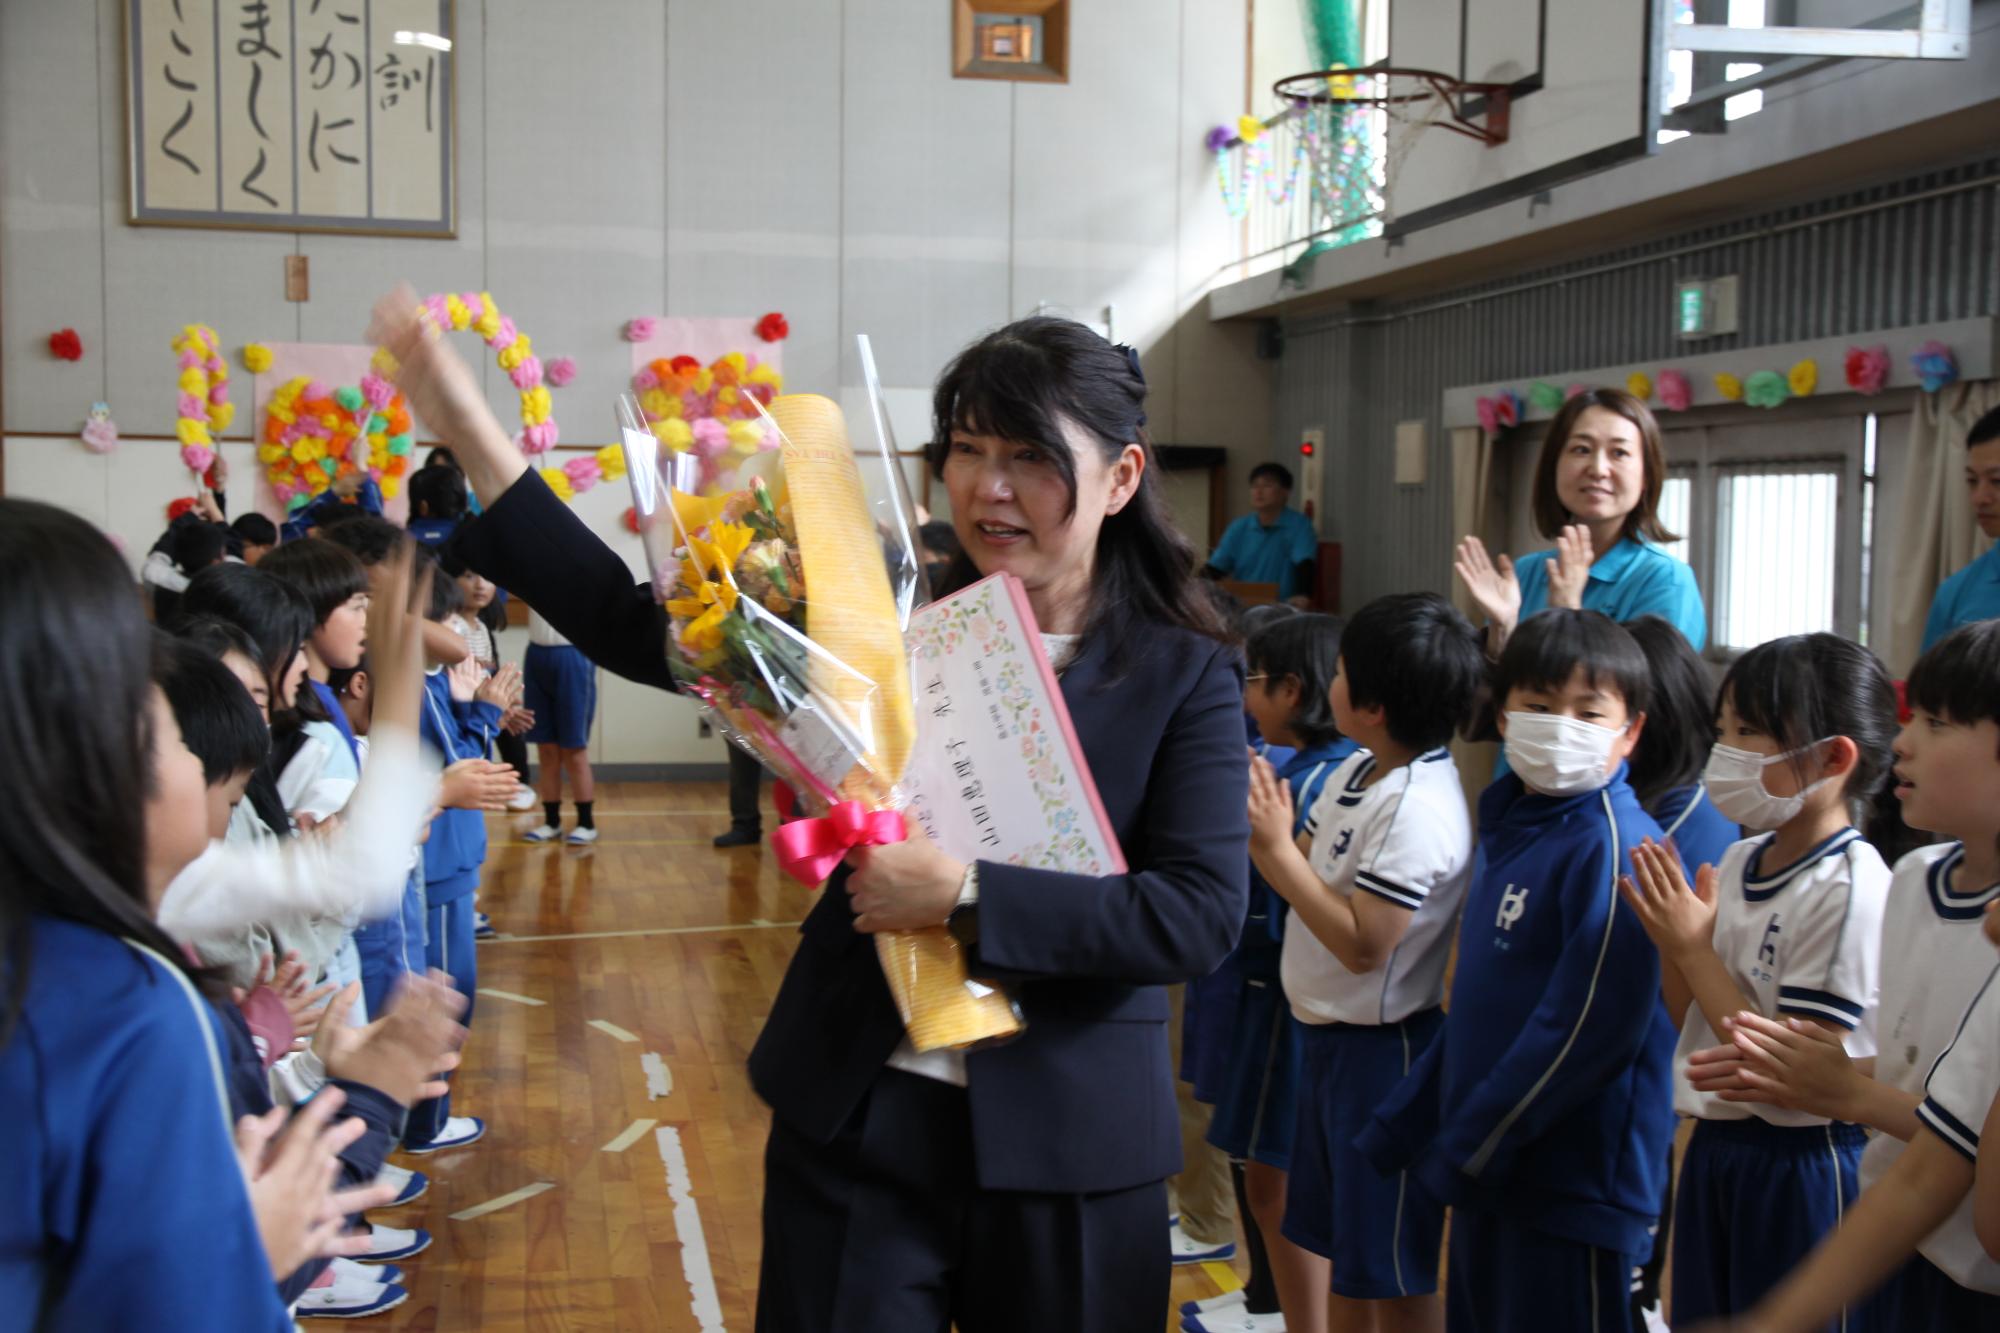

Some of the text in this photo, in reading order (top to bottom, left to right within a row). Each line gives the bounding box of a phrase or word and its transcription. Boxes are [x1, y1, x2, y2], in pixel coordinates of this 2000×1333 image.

[161, 0, 200, 174] こく
[237, 0, 281, 207] ましく
[374, 52, 434, 132] 訓
[925, 674, 954, 717] 先生
